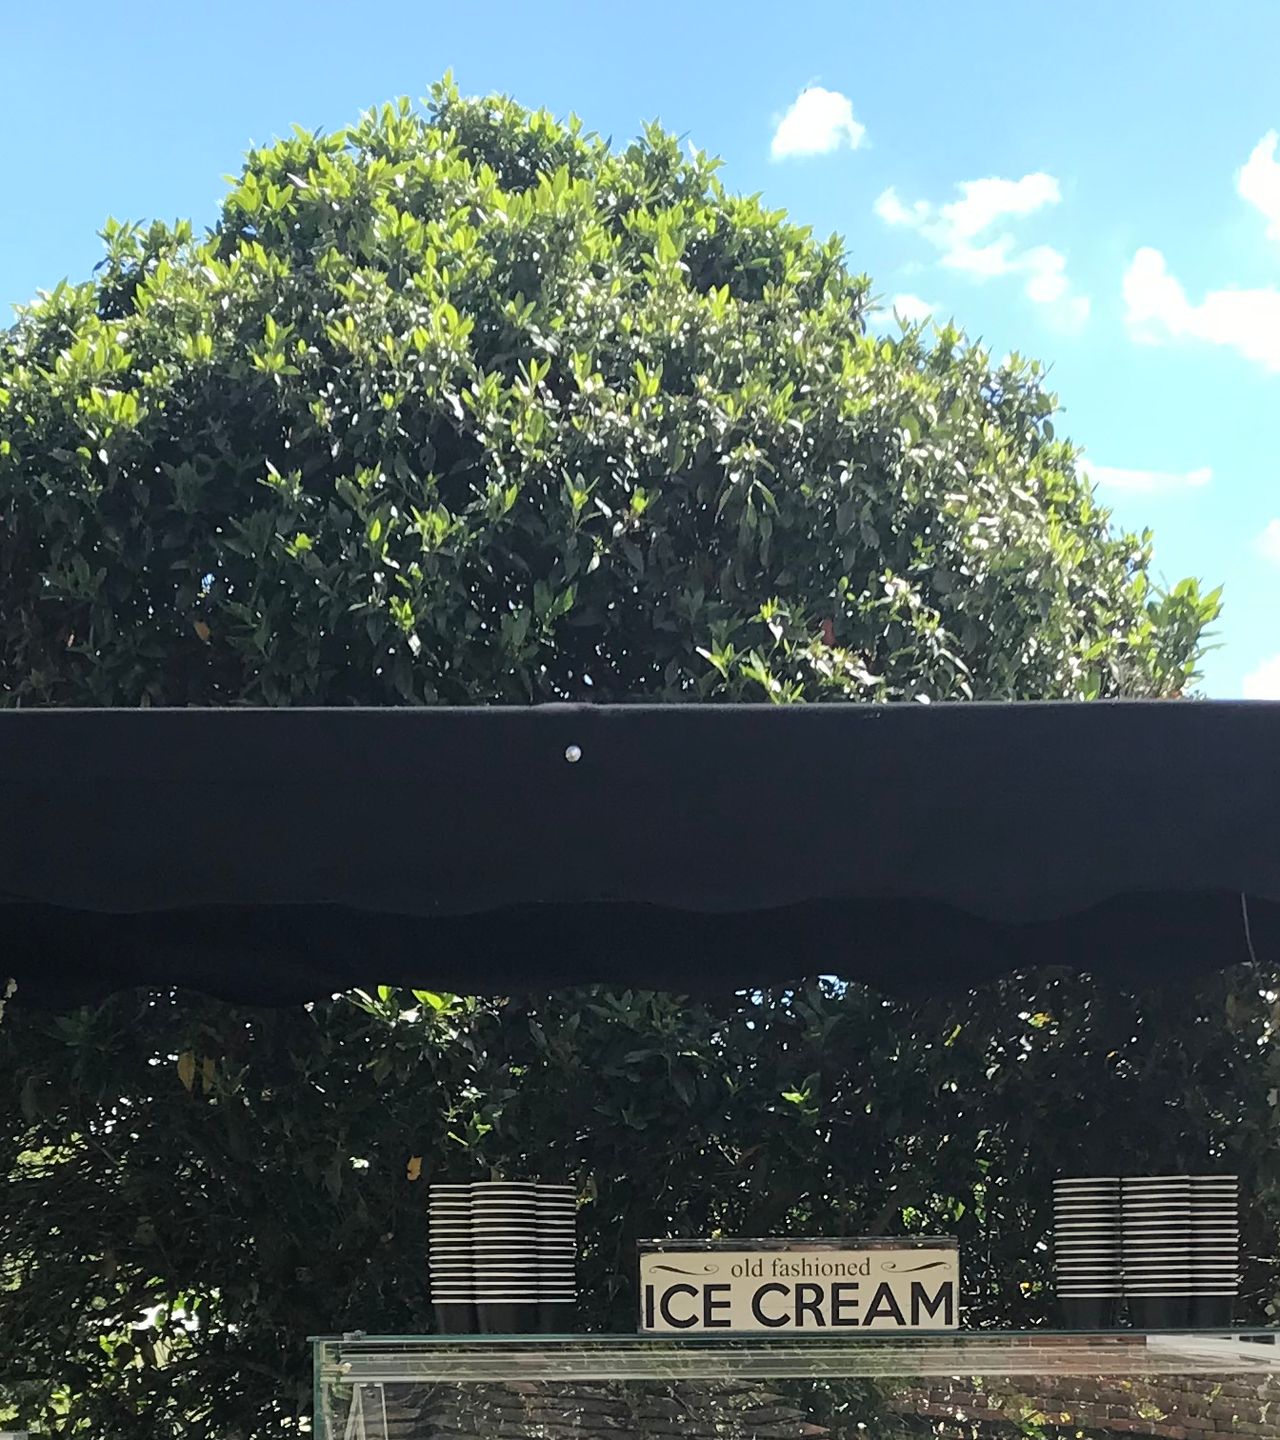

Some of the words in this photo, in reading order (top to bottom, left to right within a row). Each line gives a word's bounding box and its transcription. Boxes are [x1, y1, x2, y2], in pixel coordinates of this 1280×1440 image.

[731, 1258, 763, 1277] old
[772, 1257, 870, 1277] fashioned
[645, 1283, 731, 1329] ICE
[751, 1281, 953, 1327] CREAM
